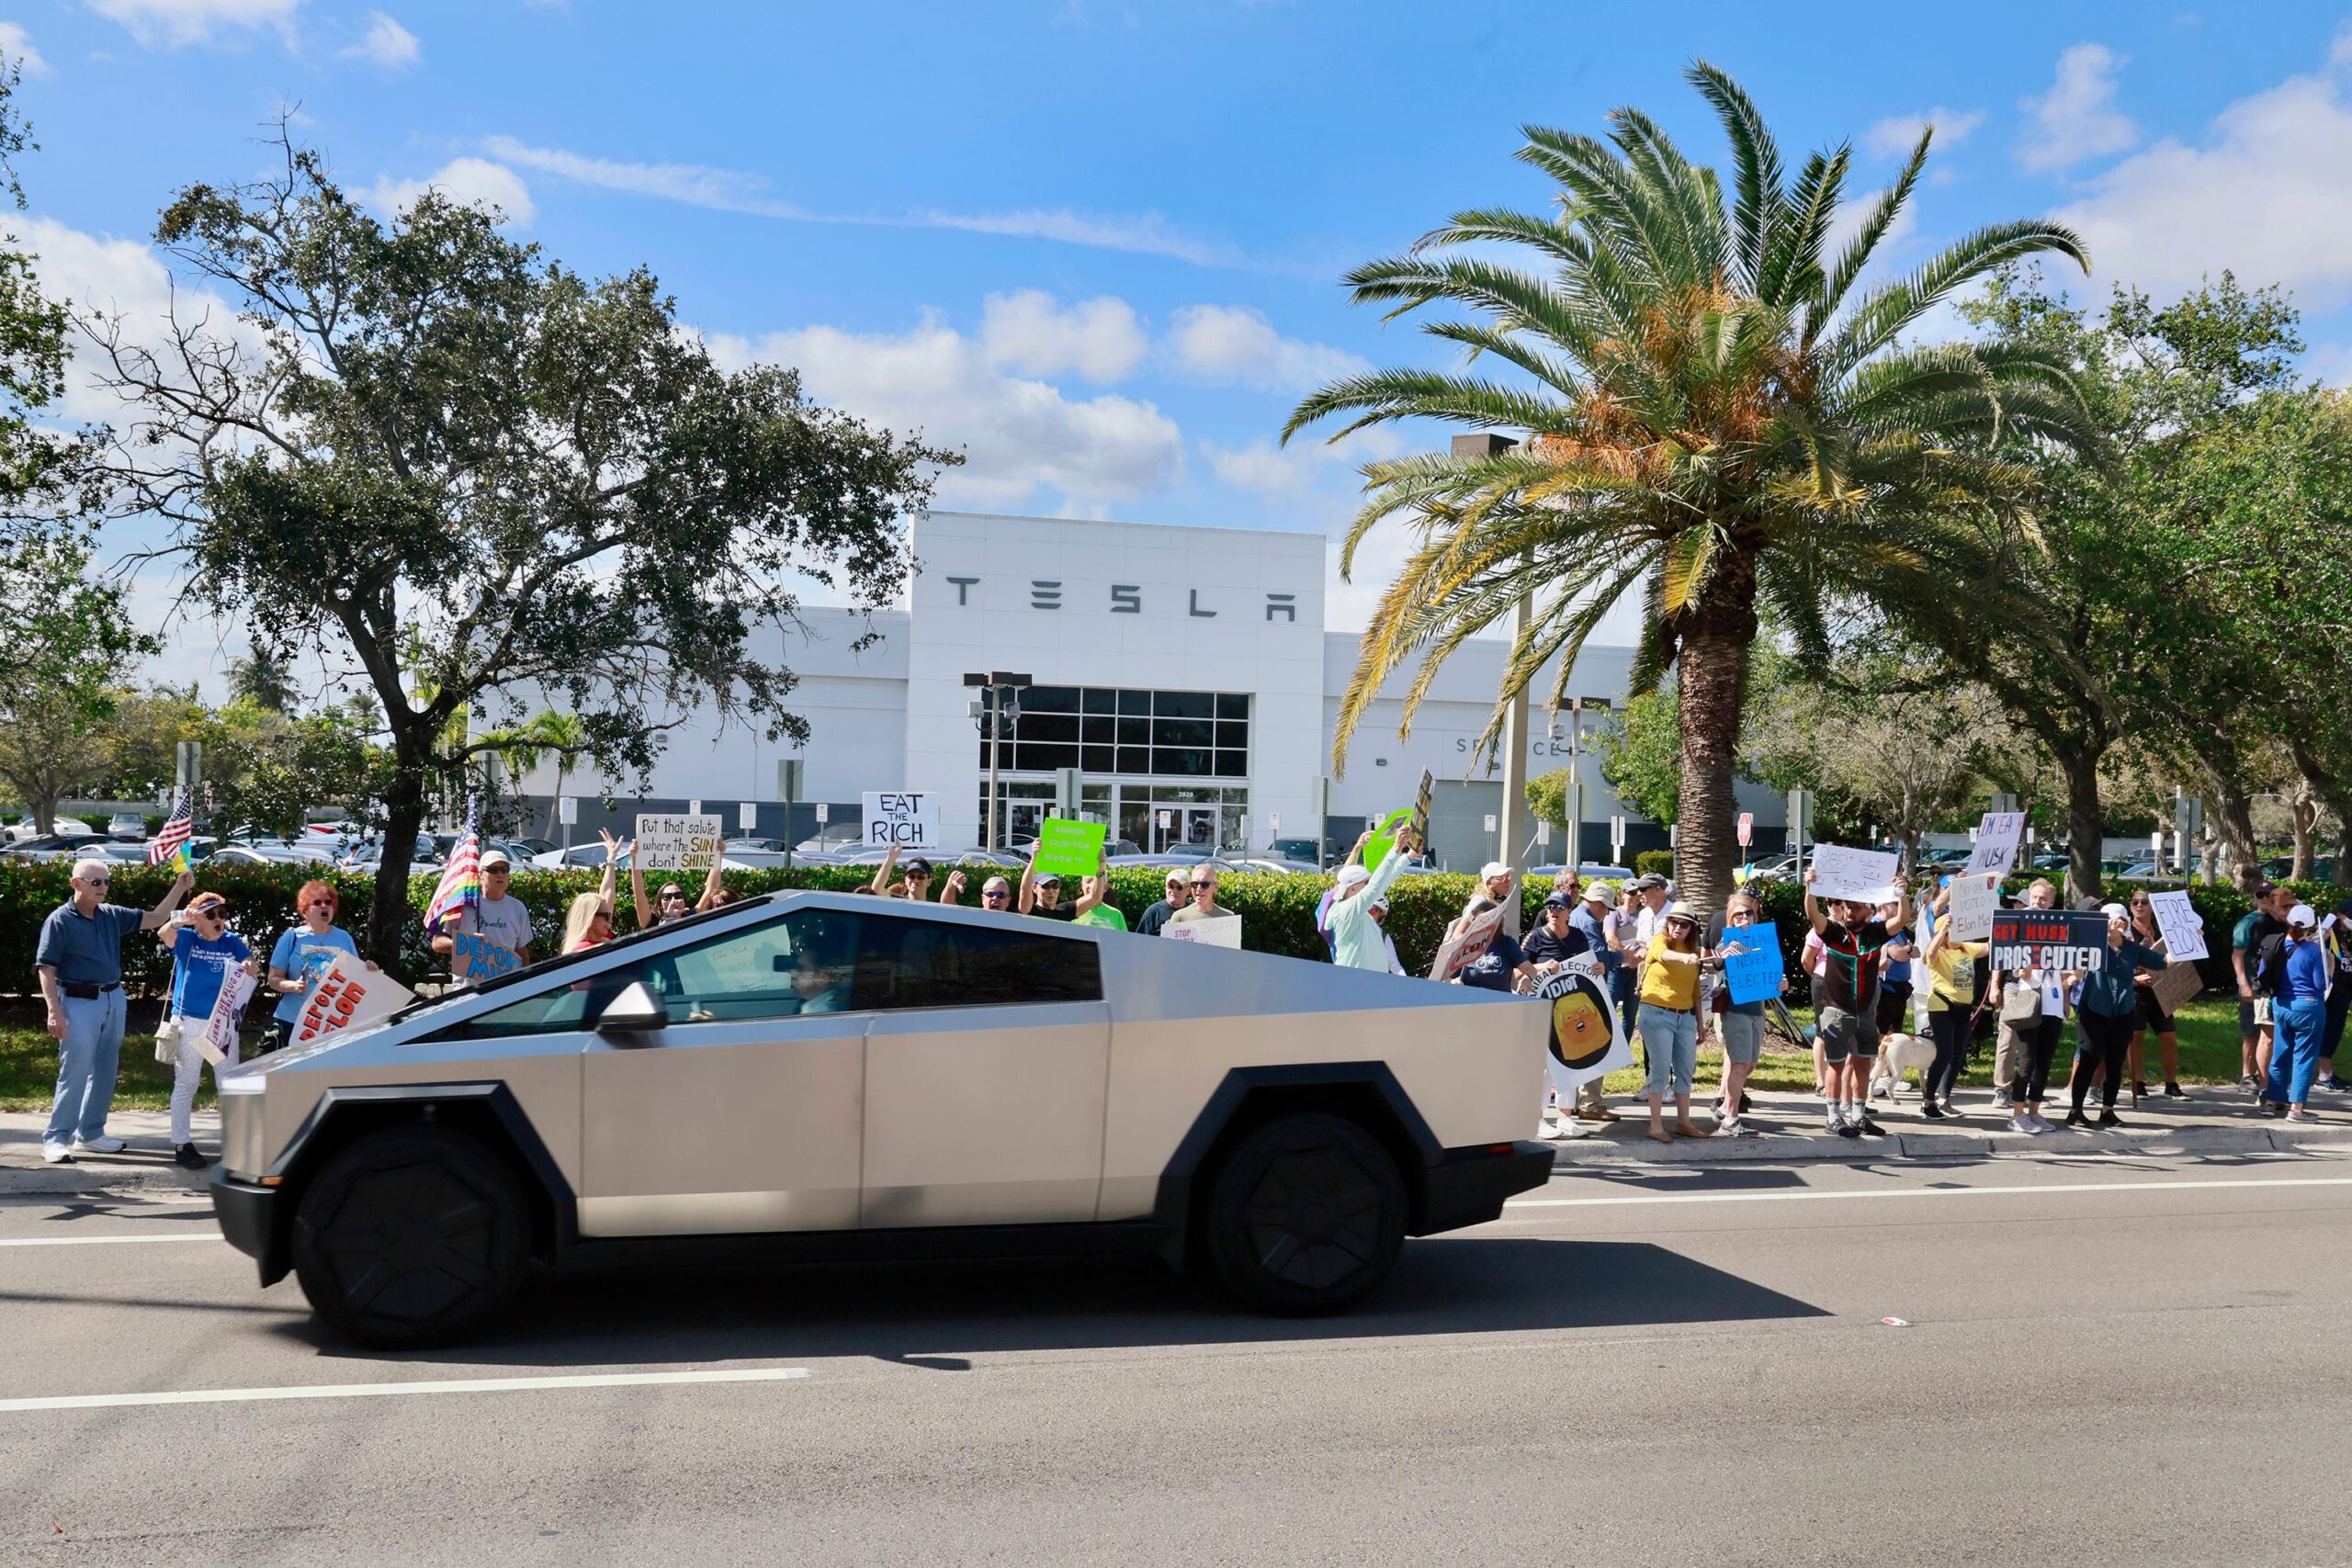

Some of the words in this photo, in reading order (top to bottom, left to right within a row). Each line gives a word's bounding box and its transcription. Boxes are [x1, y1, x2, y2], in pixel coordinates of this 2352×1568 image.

[945, 576, 1296, 623] TESLA
[1456, 738, 1560, 756] SERCE
[880, 794, 923, 814] EAT
[641, 818, 659, 834] Put
[663, 818, 685, 834] that
[687, 818, 717, 835] salute
[888, 812, 908, 821] THE
[872, 820, 923, 843] RICH
[642, 837, 672, 852] where
[673, 837, 689, 852] the
[690, 837, 714, 853] SUN
[680, 852, 716, 868] SHINE
[1976, 846, 2010, 869] MUSK
[1960, 896, 1985, 912] VOTED
[2154, 898, 2195, 926] FIRE
[1957, 917, 1976, 933] Elon
[1977, 913, 1991, 929] Mus
[1993, 924, 2018, 941] GET
[2025, 924, 2068, 942] MUSK
[1174, 929, 1192, 938] STOP
[2165, 926, 2205, 956] ELON
[1736, 953, 1770, 971] NEVER
[1994, 945, 2102, 971] PROSECUTED
[1544, 974, 1579, 999] IDIOT
[211, 1017, 221, 1042] JERK
[218, 998, 228, 1015] THE
[224, 976, 237, 998] PLUG
[299, 968, 347, 1042] DEPORT
